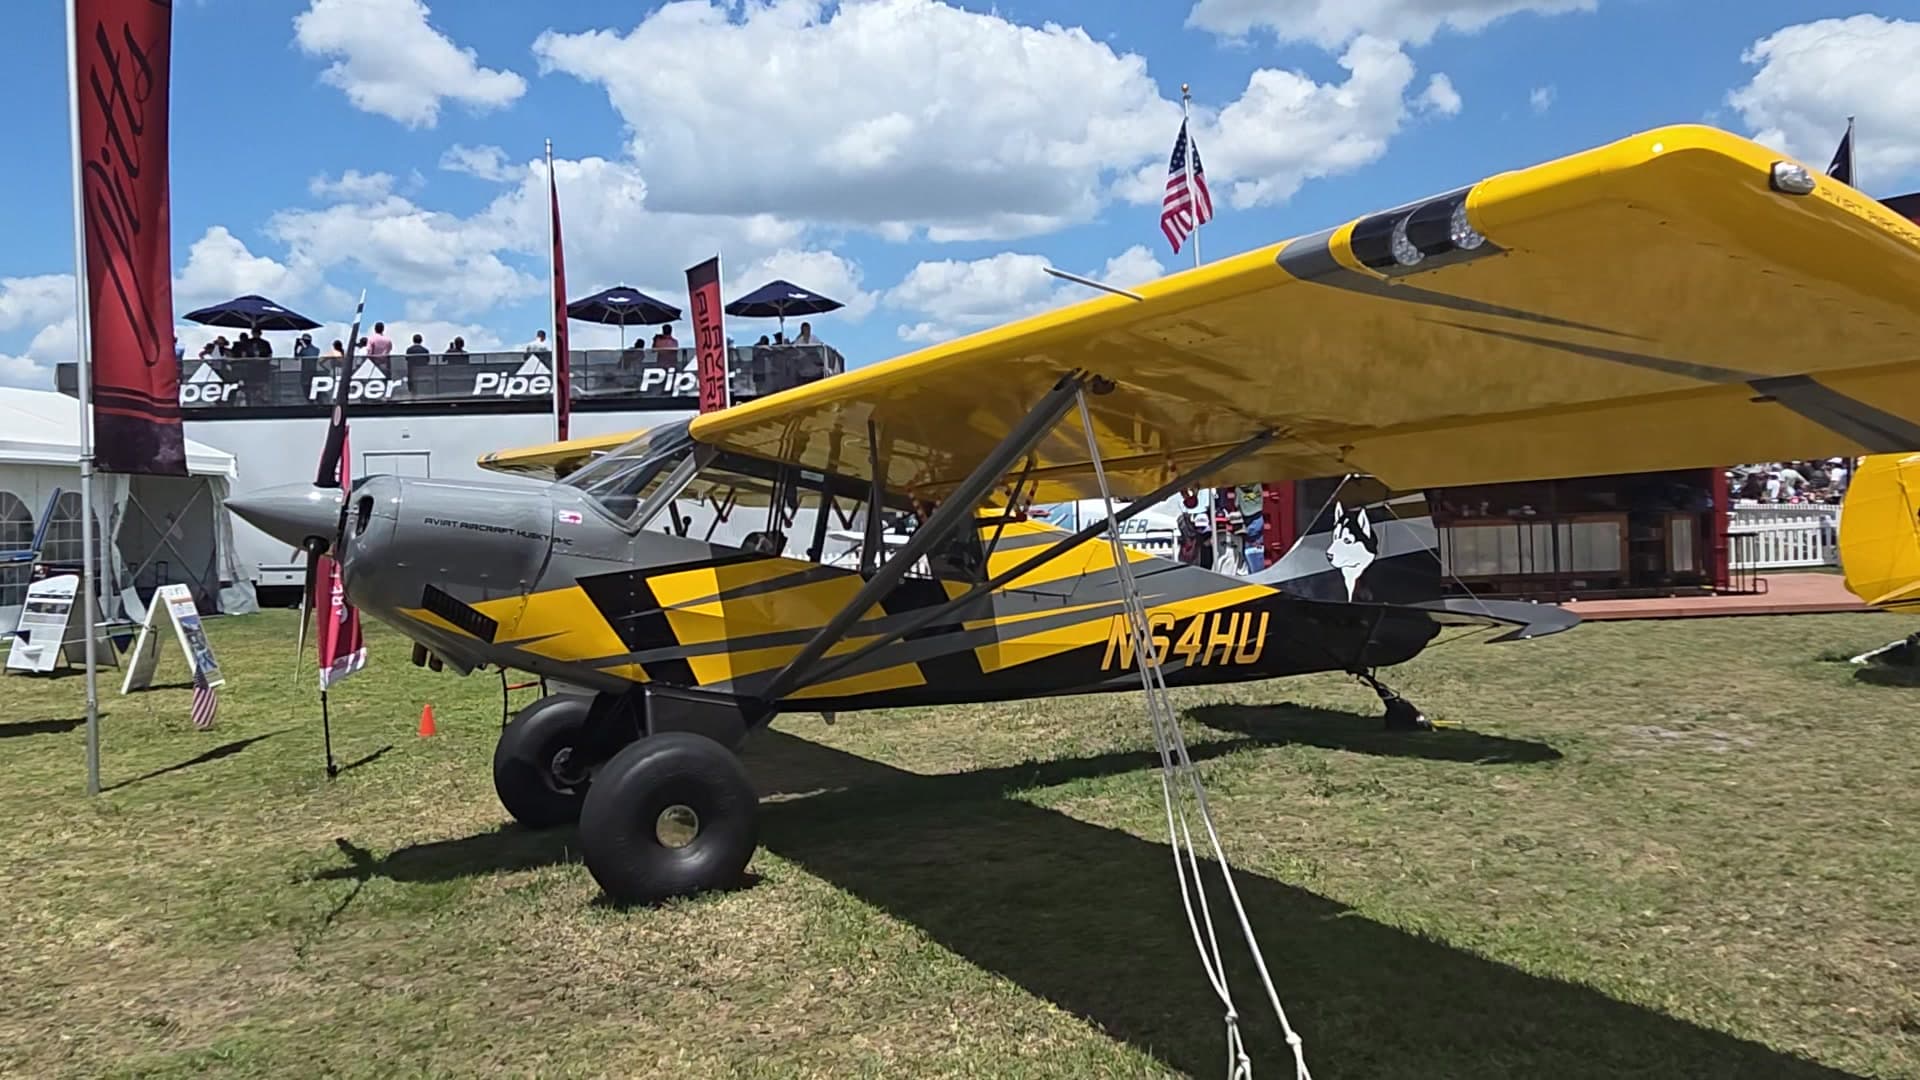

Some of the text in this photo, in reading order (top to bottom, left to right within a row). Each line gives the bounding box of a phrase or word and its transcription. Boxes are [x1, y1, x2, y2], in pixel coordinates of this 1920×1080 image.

[695, 290, 717, 413] AIRCR
[711, 324, 726, 410] AVIA
[179, 380, 238, 407] per
[472, 371, 556, 400] Pipe
